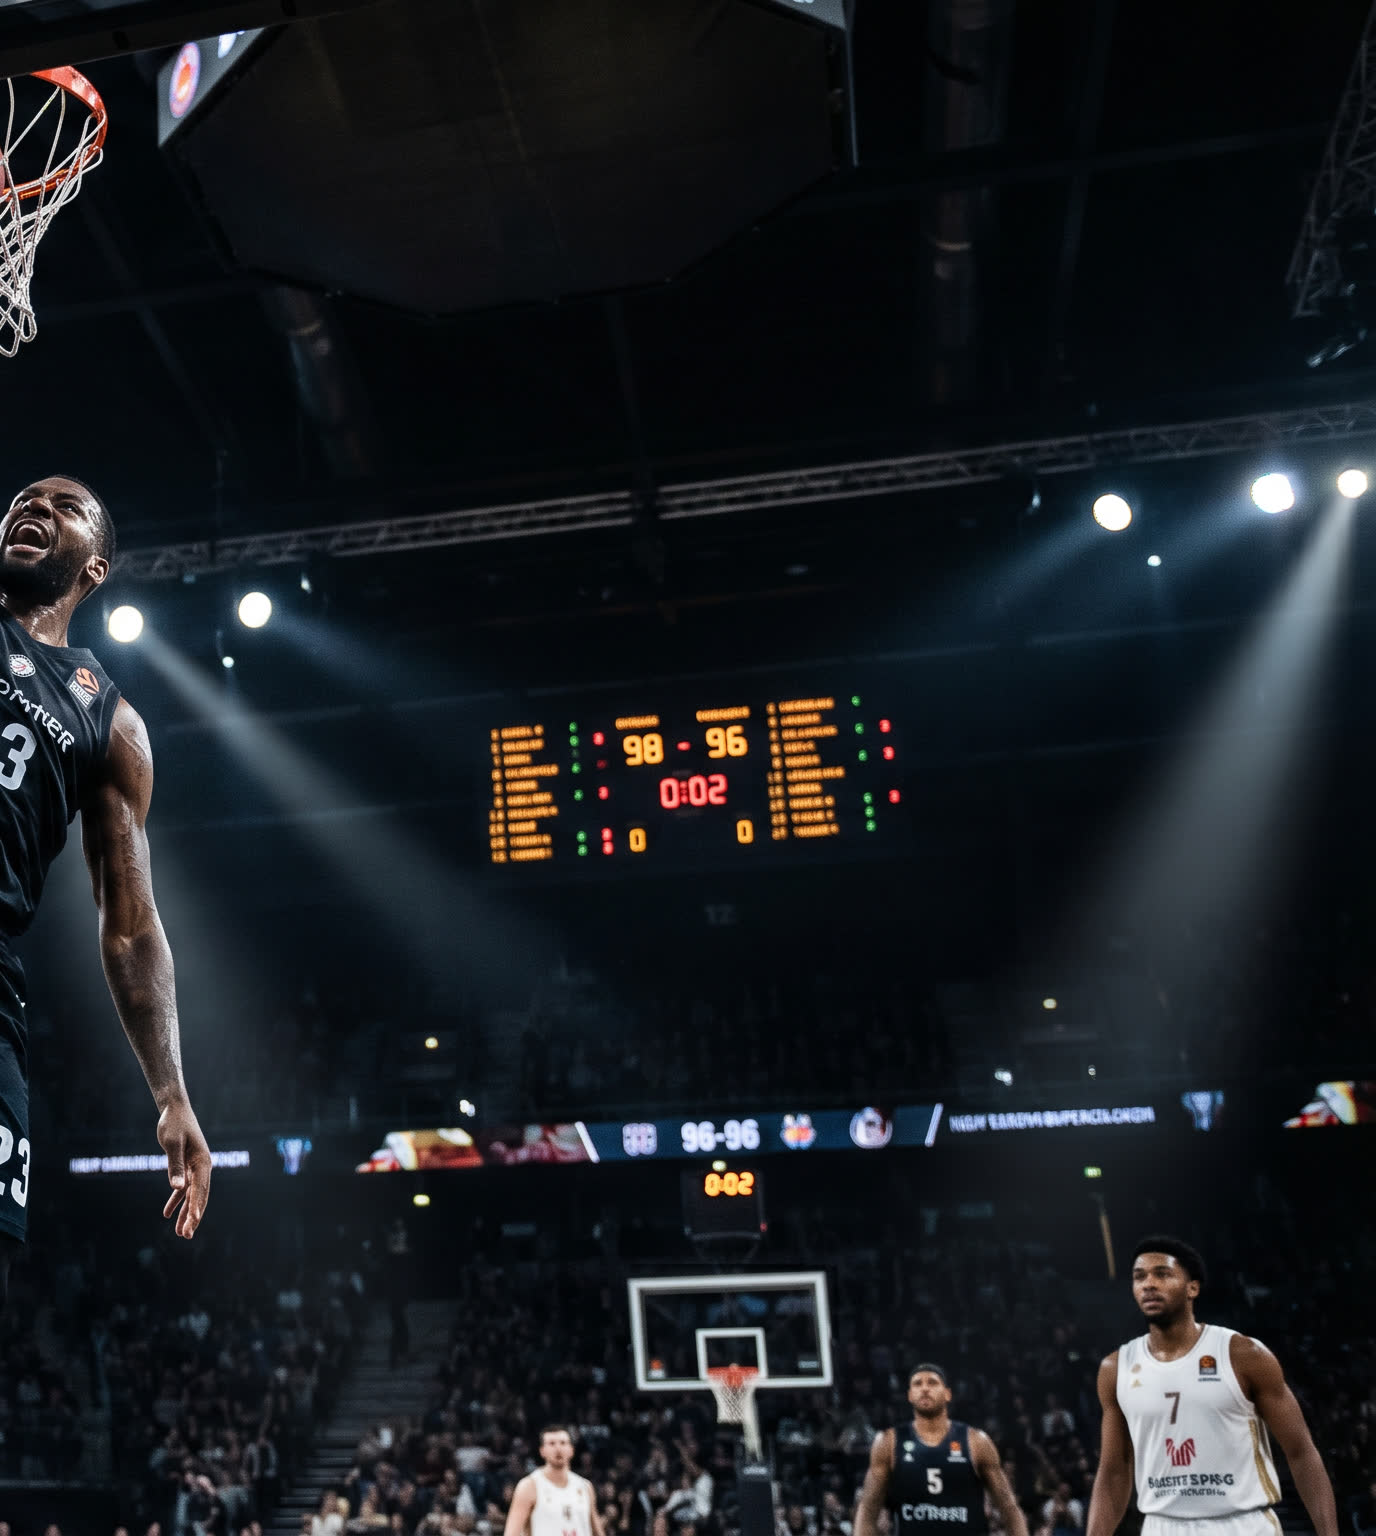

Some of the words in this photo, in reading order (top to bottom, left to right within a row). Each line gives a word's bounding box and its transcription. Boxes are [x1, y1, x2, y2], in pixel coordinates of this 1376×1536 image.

[622, 732, 664, 767] 98
[705, 725, 749, 760] 96
[659, 773, 728, 810] 0:02
[629, 828, 647, 853] 0
[737, 820, 754, 844] 0
[680, 1118, 760, 1154] 96-96
[1164, 1391, 1181, 1425] 7
[926, 1467, 944, 1495] 5
